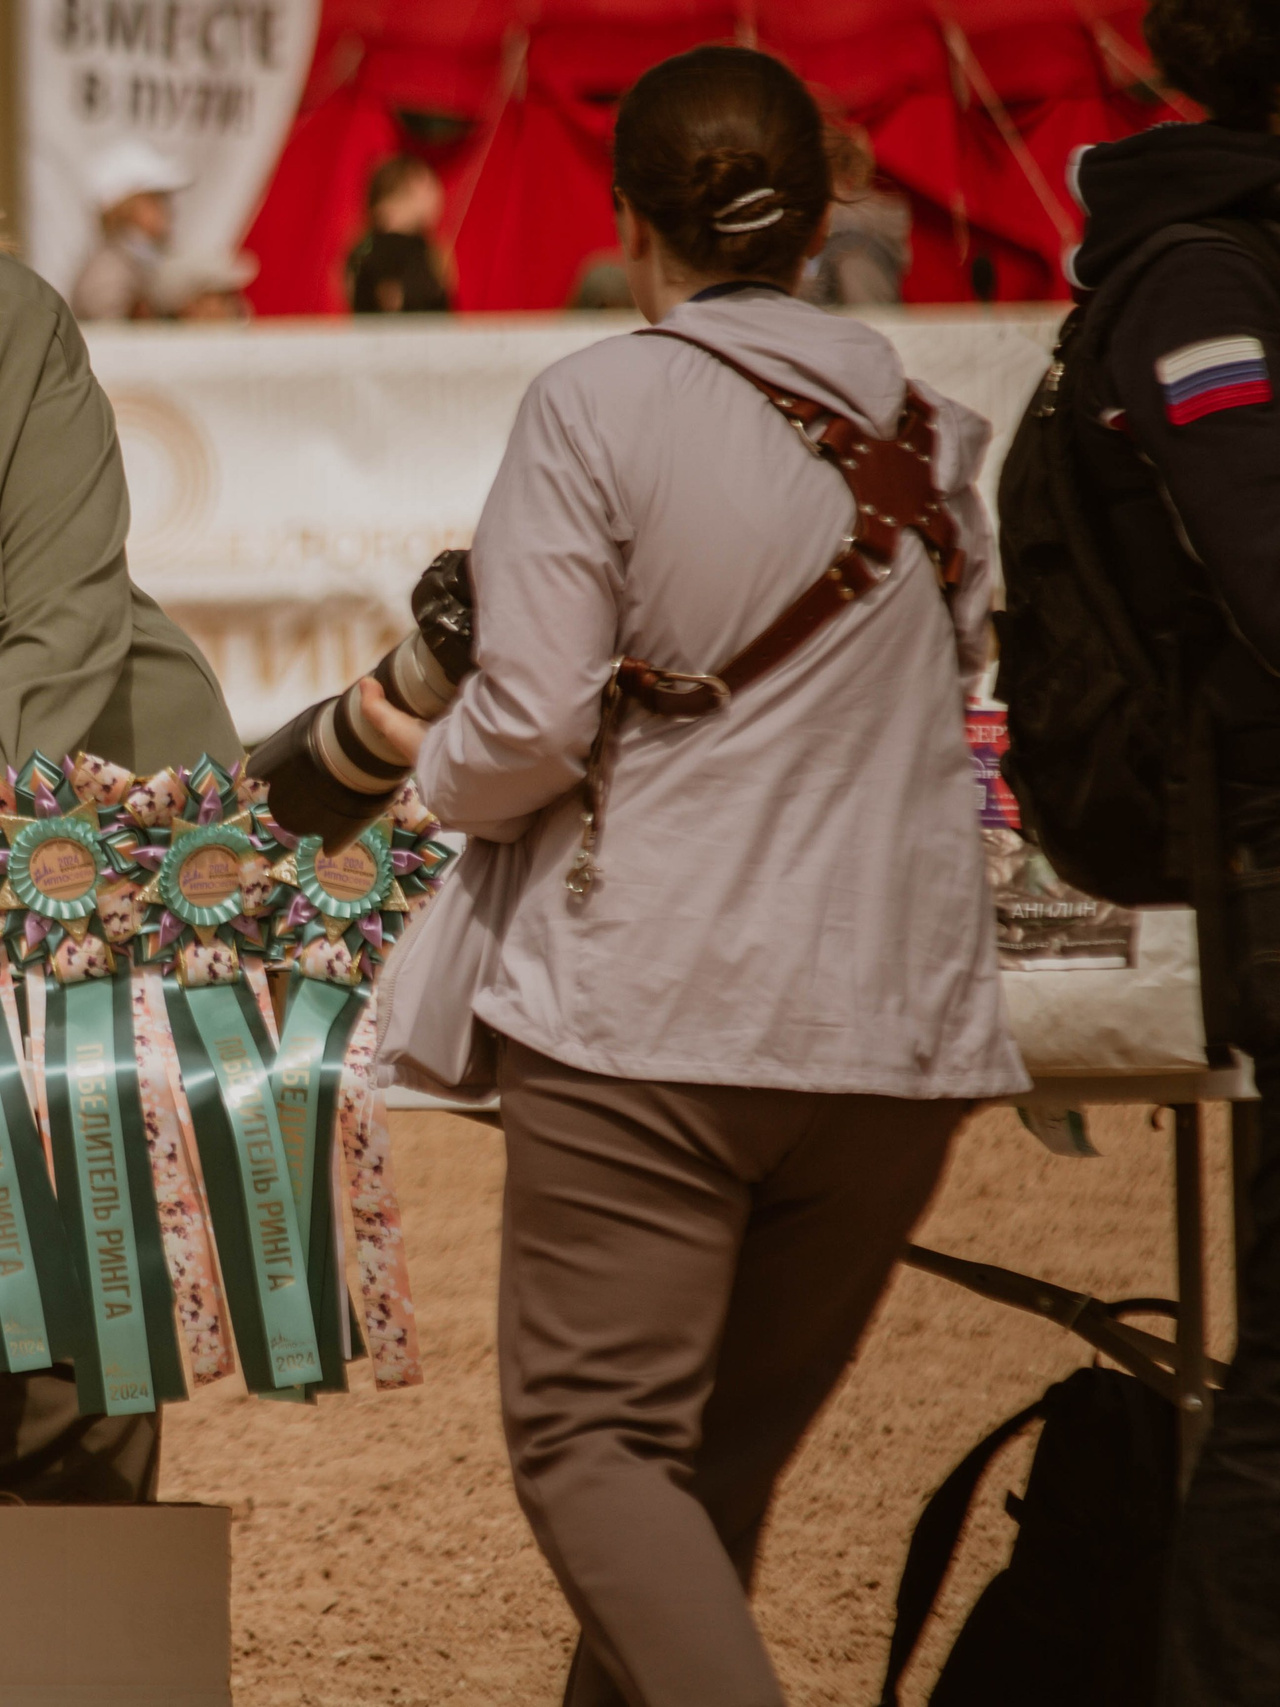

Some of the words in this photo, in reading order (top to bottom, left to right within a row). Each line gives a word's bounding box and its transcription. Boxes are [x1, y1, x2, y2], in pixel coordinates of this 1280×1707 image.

[76, 1043, 122, 1221] ПОБЕДИТЕЛЬ
[96, 1229, 133, 1320] РИНГА
[257, 1200, 297, 1293] РИНГА
[10, 1337, 45, 1357] 2024
[276, 1351, 316, 1373] 2024
[109, 1382, 149, 1400] 2024
